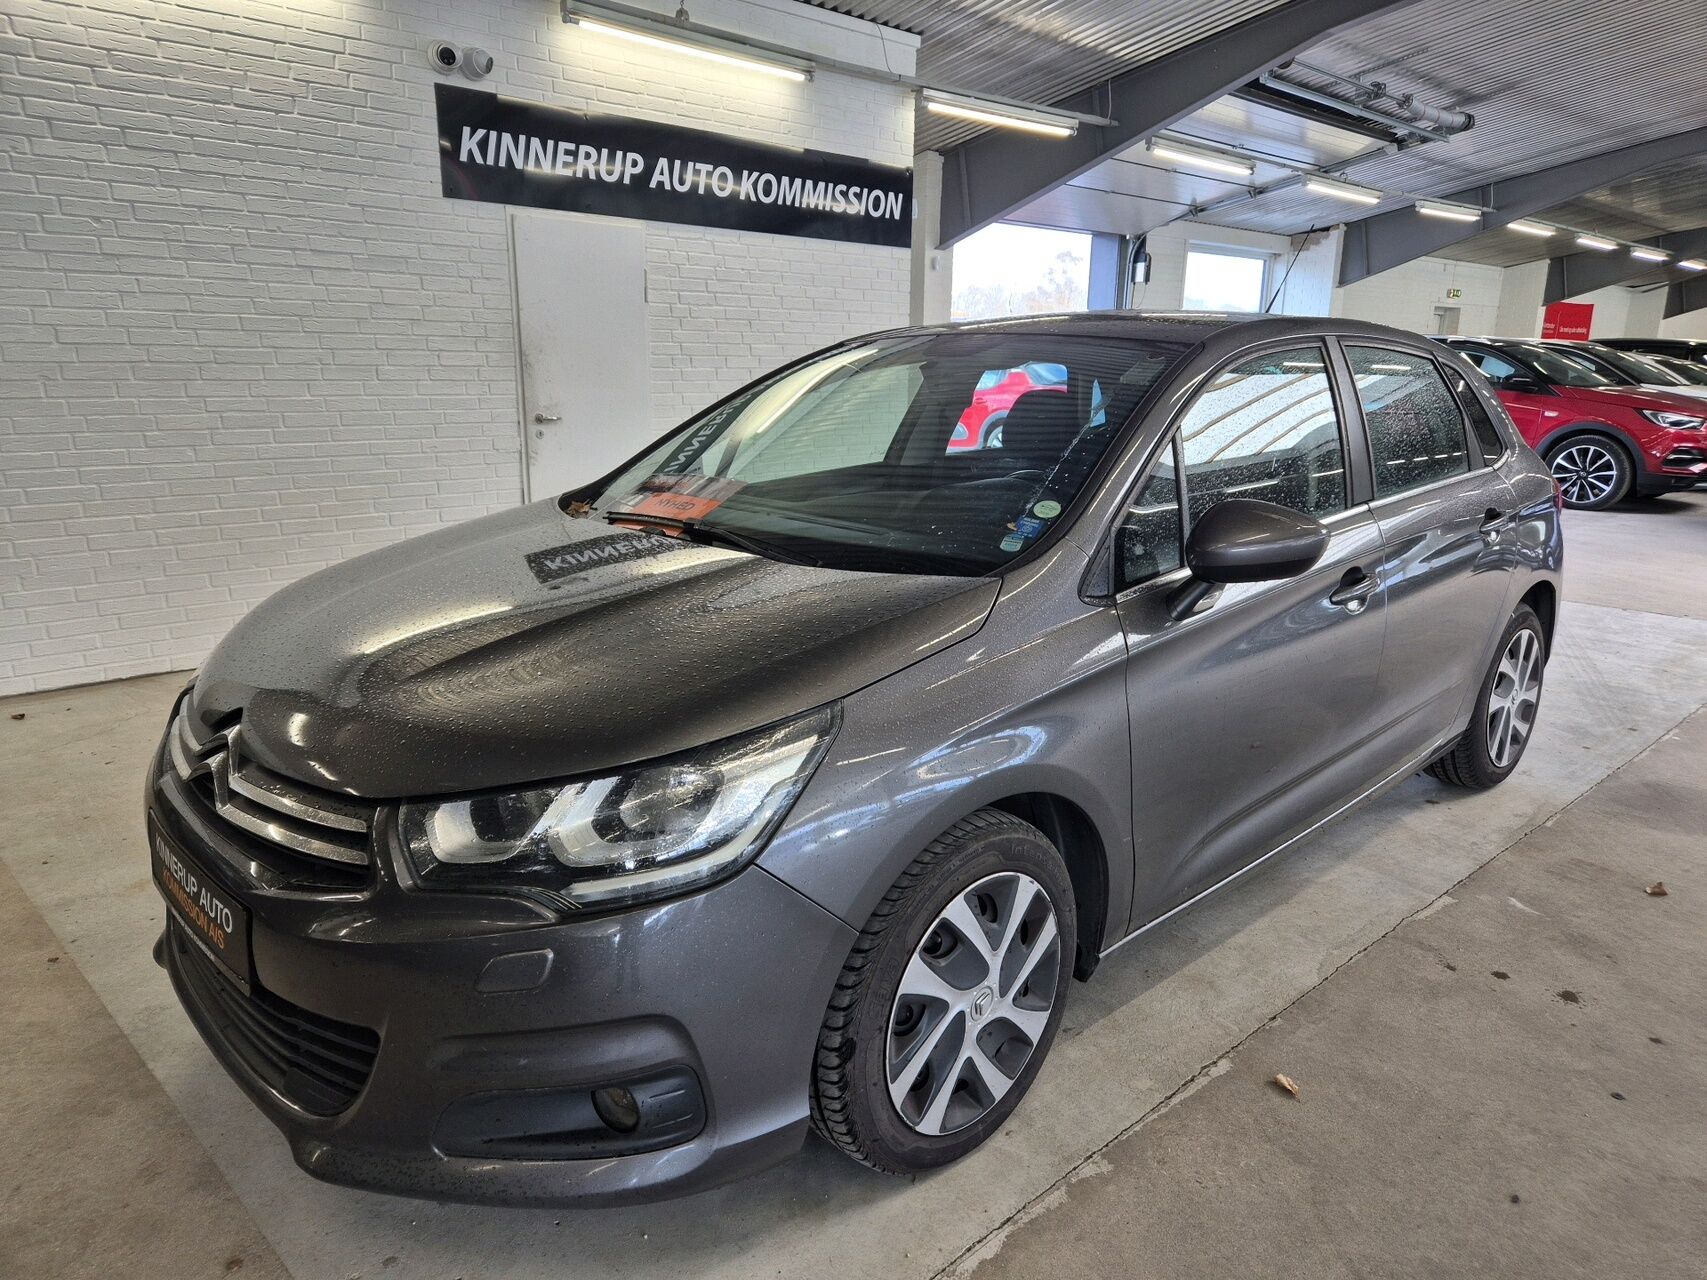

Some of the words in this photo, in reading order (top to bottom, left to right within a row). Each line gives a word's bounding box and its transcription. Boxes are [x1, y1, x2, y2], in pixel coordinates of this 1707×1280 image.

[459, 125, 645, 186] KINNERUP
[649, 157, 735, 198] AUTO
[739, 170, 904, 220] KOMMISSION
[155, 832, 198, 897] KINNERUP
[199, 887, 233, 934] AUTO
[209, 922, 225, 949] A/S
